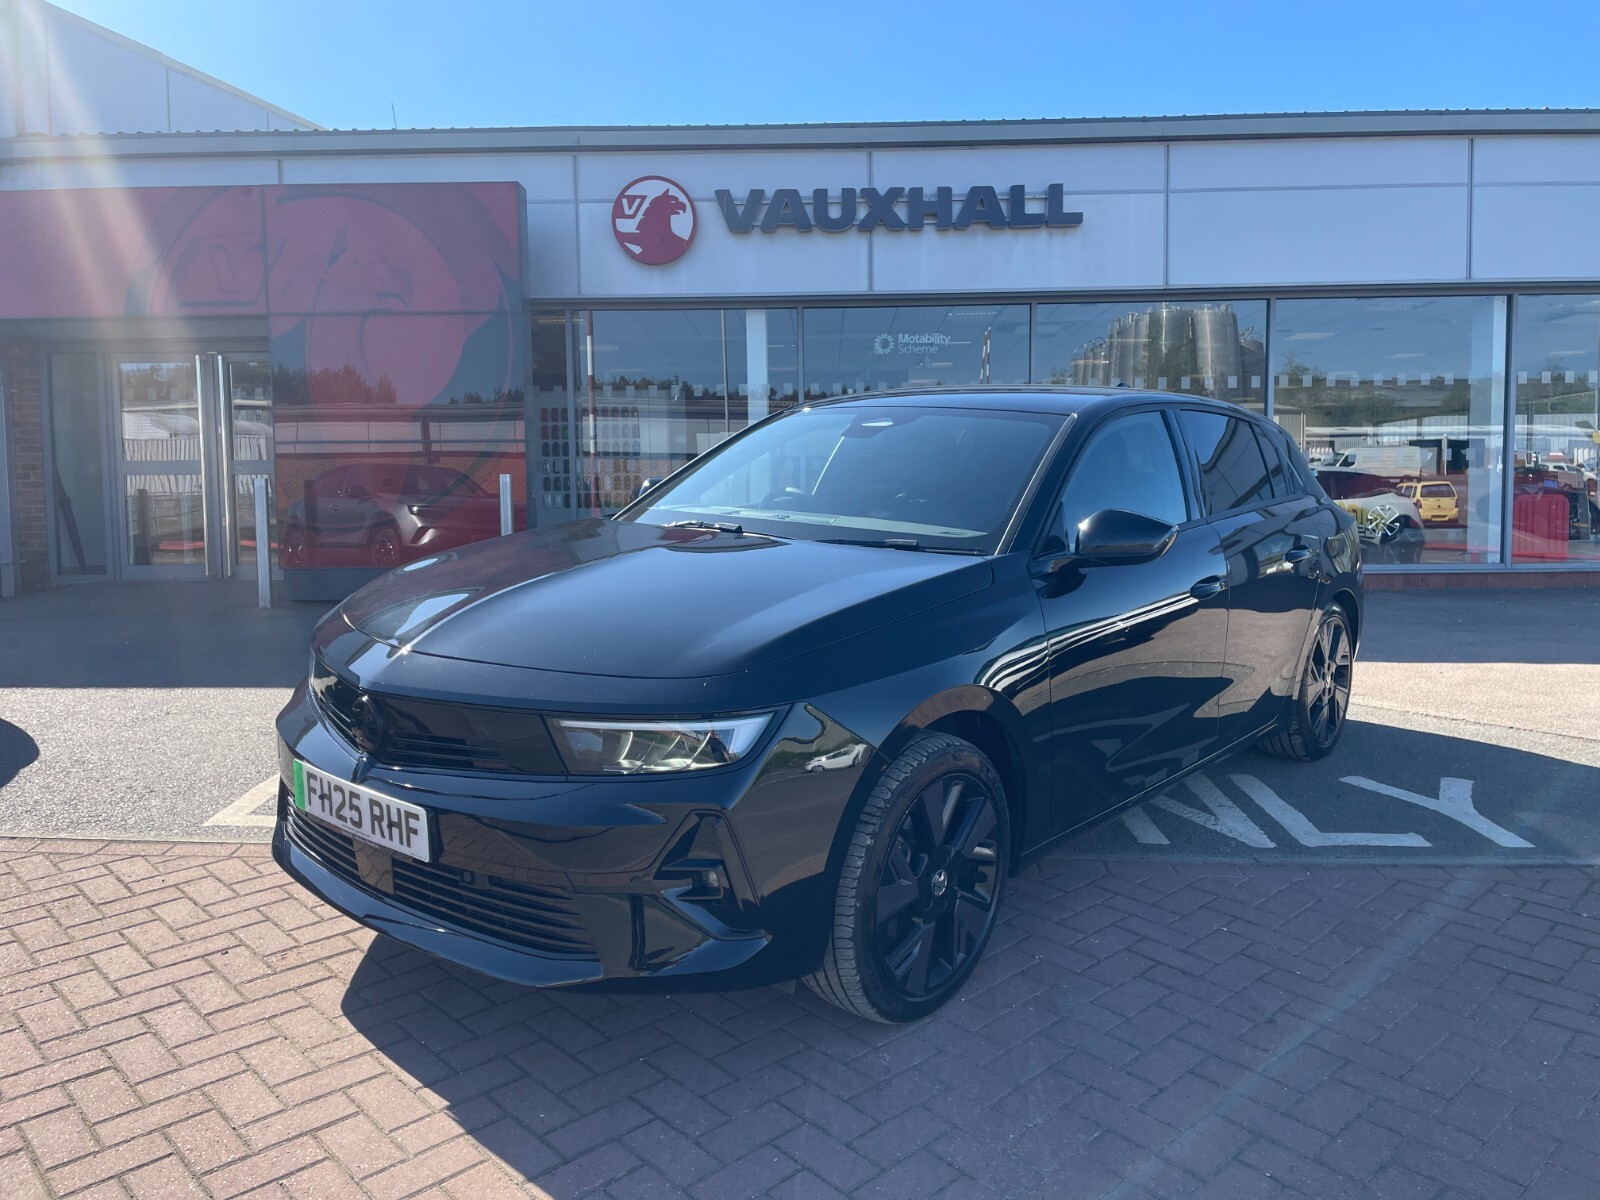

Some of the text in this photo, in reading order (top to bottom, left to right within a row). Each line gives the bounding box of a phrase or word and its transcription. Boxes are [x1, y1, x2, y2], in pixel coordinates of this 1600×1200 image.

[714, 183, 1084, 233] VAUXHALL
[898, 333, 951, 346] Motability
[898, 343, 939, 354] Scheme
[306, 771, 420, 849] FH25 RHF
[1119, 774, 1537, 848] NLY
